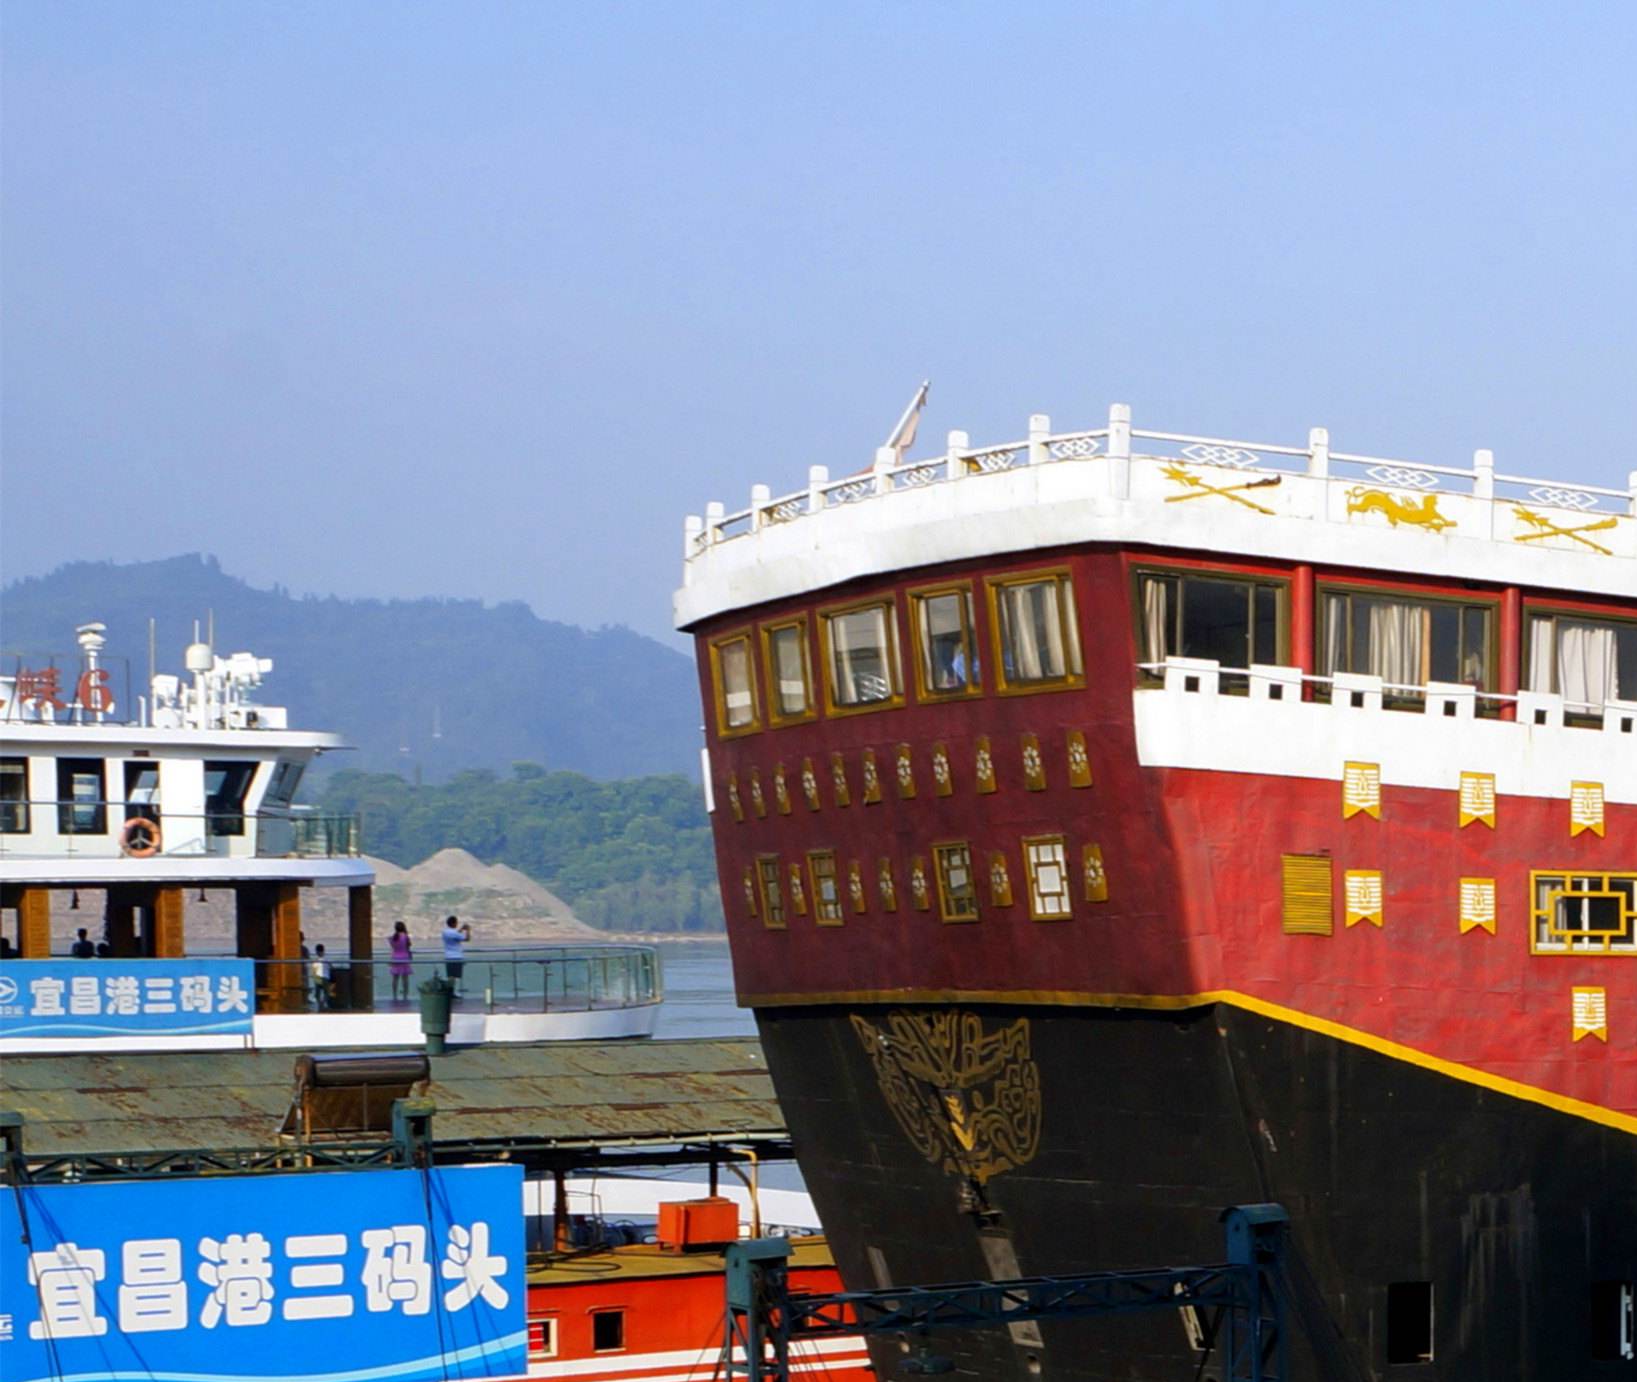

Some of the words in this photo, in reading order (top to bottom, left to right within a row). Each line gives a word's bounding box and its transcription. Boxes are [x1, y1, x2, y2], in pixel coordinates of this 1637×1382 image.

[0, 666, 113, 712] 峡6
[30, 975, 248, 1016] 宜昌港三码头
[28, 1222, 510, 1340] 宜昌港三码头
